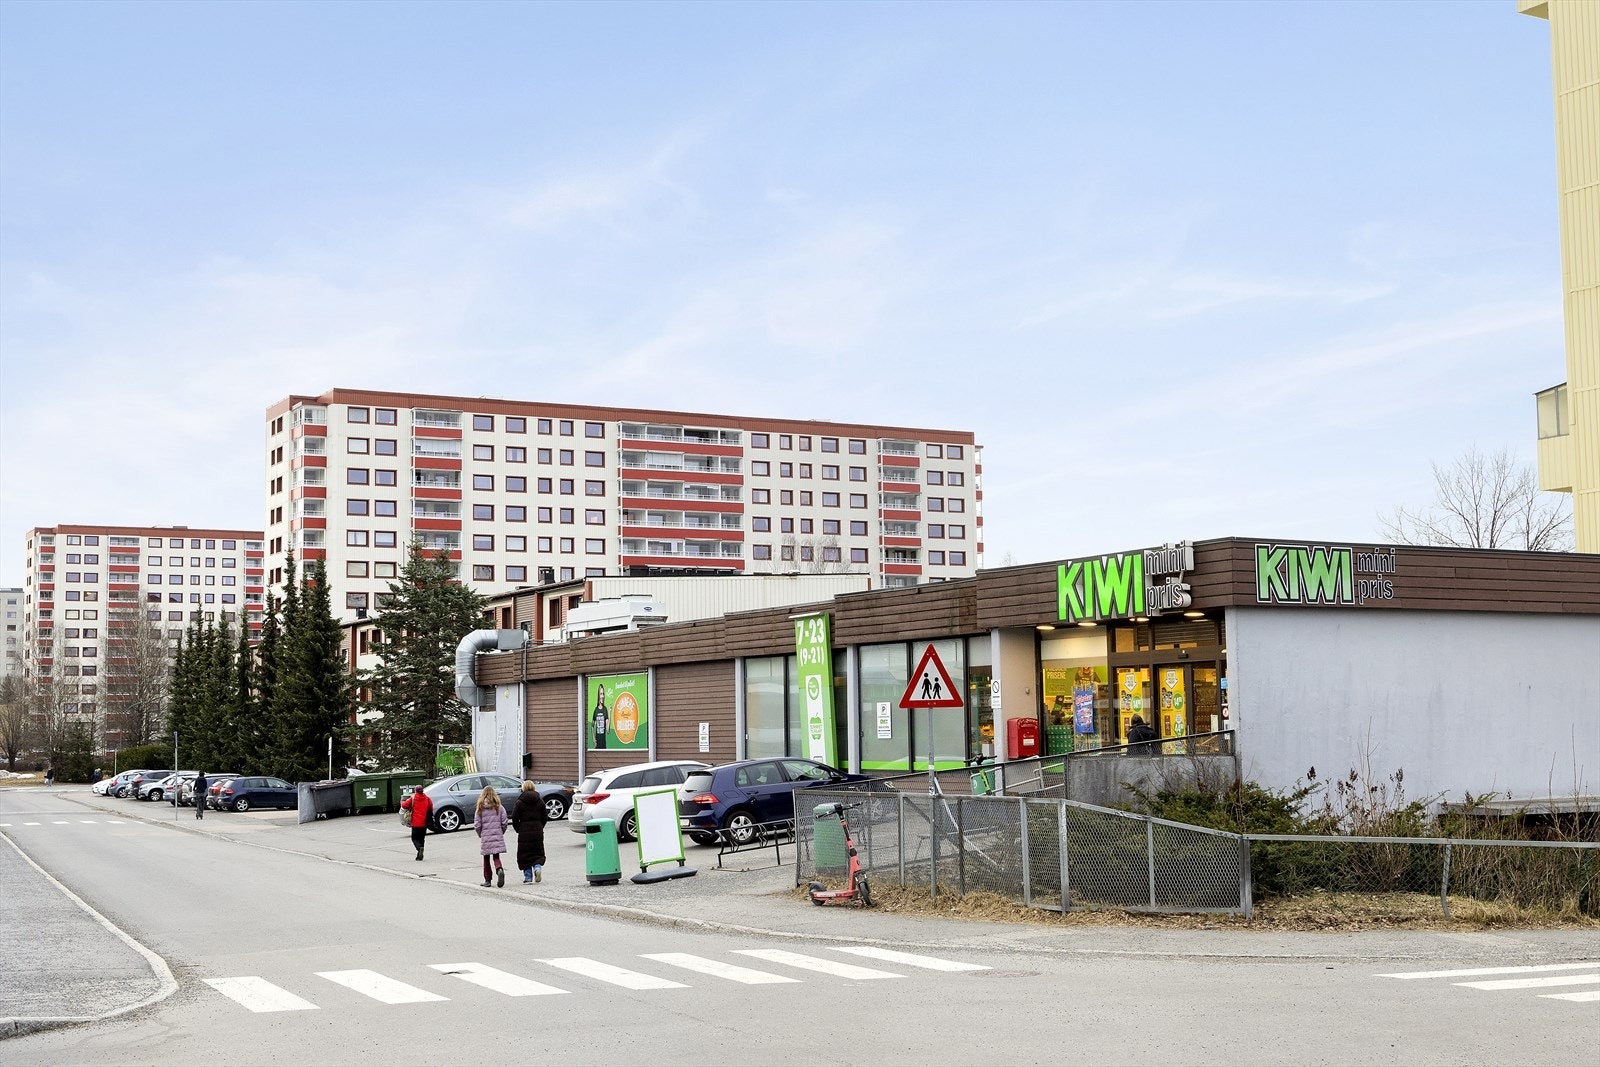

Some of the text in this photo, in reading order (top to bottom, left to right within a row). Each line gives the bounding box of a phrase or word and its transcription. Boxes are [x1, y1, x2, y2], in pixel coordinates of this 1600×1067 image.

[1145, 540, 1189, 576] mini
[1357, 547, 1396, 573] mini
[1056, 551, 1145, 622] KIWI
[1255, 544, 1355, 605] KIWI
[1357, 574, 1393, 605] pris
[1145, 577, 1185, 616] pris
[796, 618, 825, 646] 7-23
[800, 646, 824, 667] (9-21)
[1047, 671, 1066, 679] PRISENE
